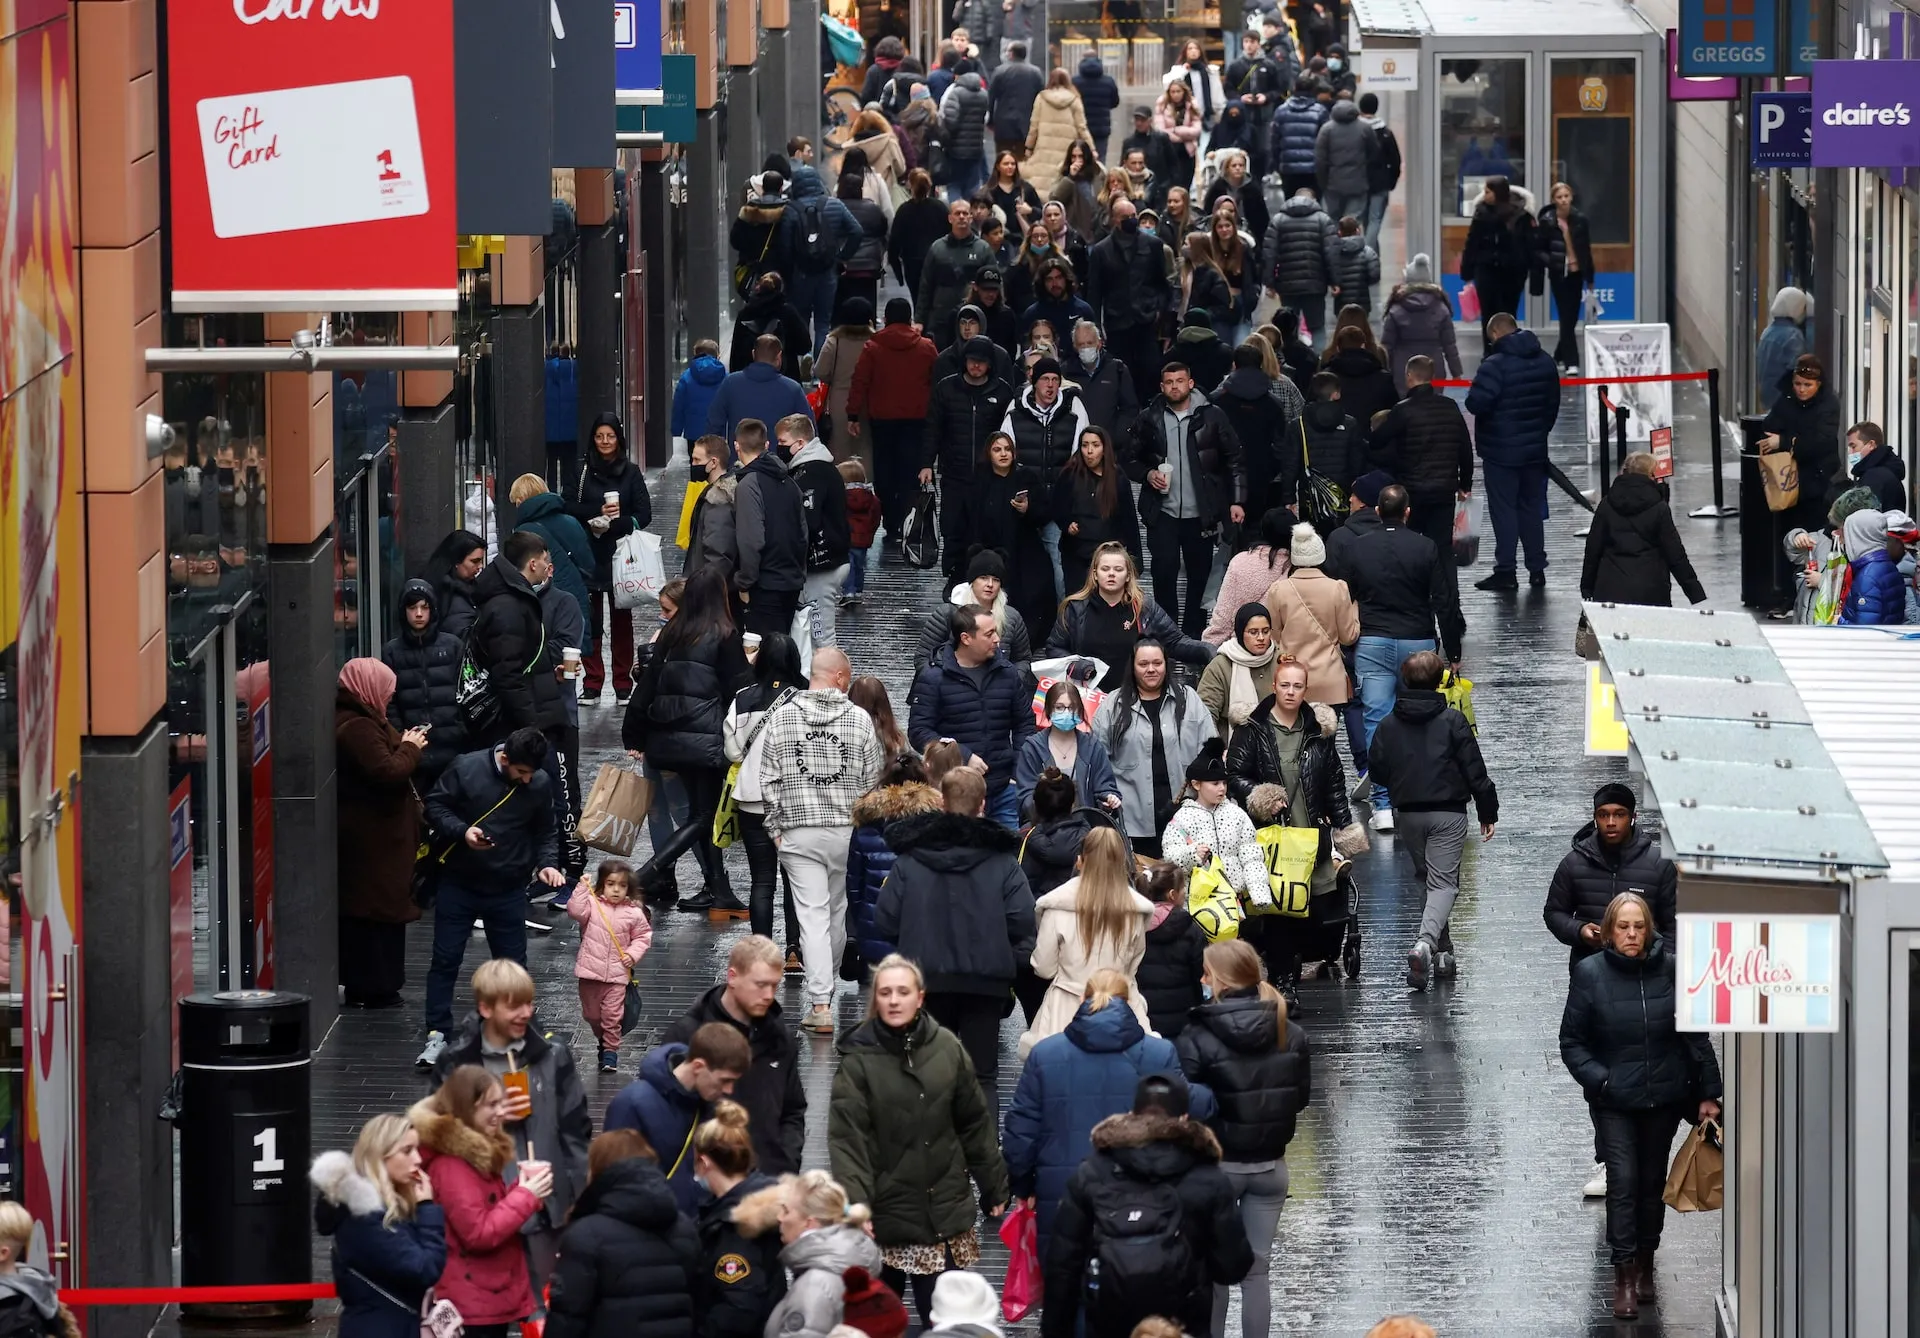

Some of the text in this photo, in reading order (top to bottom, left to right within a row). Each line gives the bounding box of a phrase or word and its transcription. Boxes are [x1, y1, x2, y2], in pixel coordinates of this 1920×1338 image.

[1692, 46, 1766, 63] GREGGS
[214, 106, 264, 148] Gift
[1760, 103, 1785, 144] P
[1822, 102, 1911, 126] claire's
[228, 134, 281, 169] Card
[377, 149, 401, 181] 1
[615, 576, 656, 594] next
[805, 730, 840, 745] CRAVE
[1687, 948, 1792, 994] Millie's
[1762, 985, 1830, 994] COOKIES
[253, 1127, 284, 1172] 1
